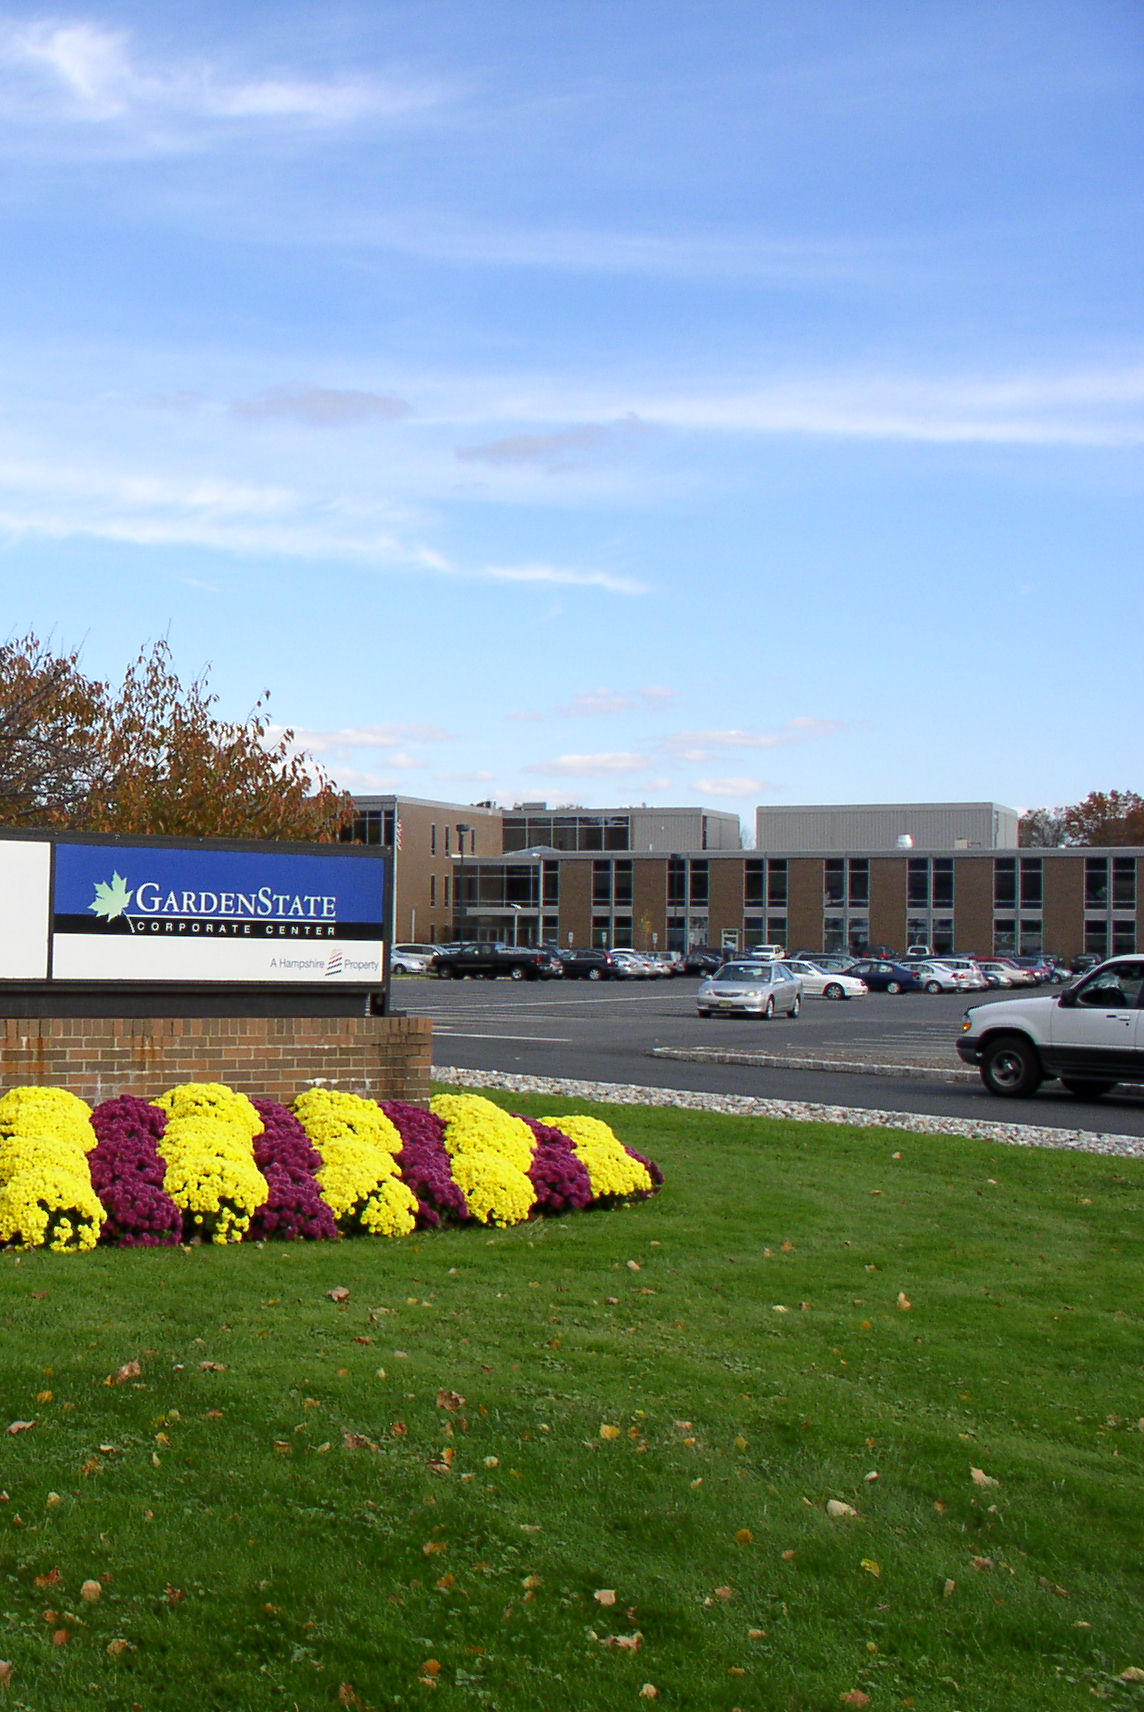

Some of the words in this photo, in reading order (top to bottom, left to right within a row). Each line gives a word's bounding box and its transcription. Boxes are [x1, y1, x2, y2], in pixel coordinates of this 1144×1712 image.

[137, 921, 251, 934] CORPORATE
[266, 925, 336, 936] CENTER
[270, 958, 278, 968] A
[279, 958, 325, 970] Hampshire
[344, 959, 379, 972] Property
